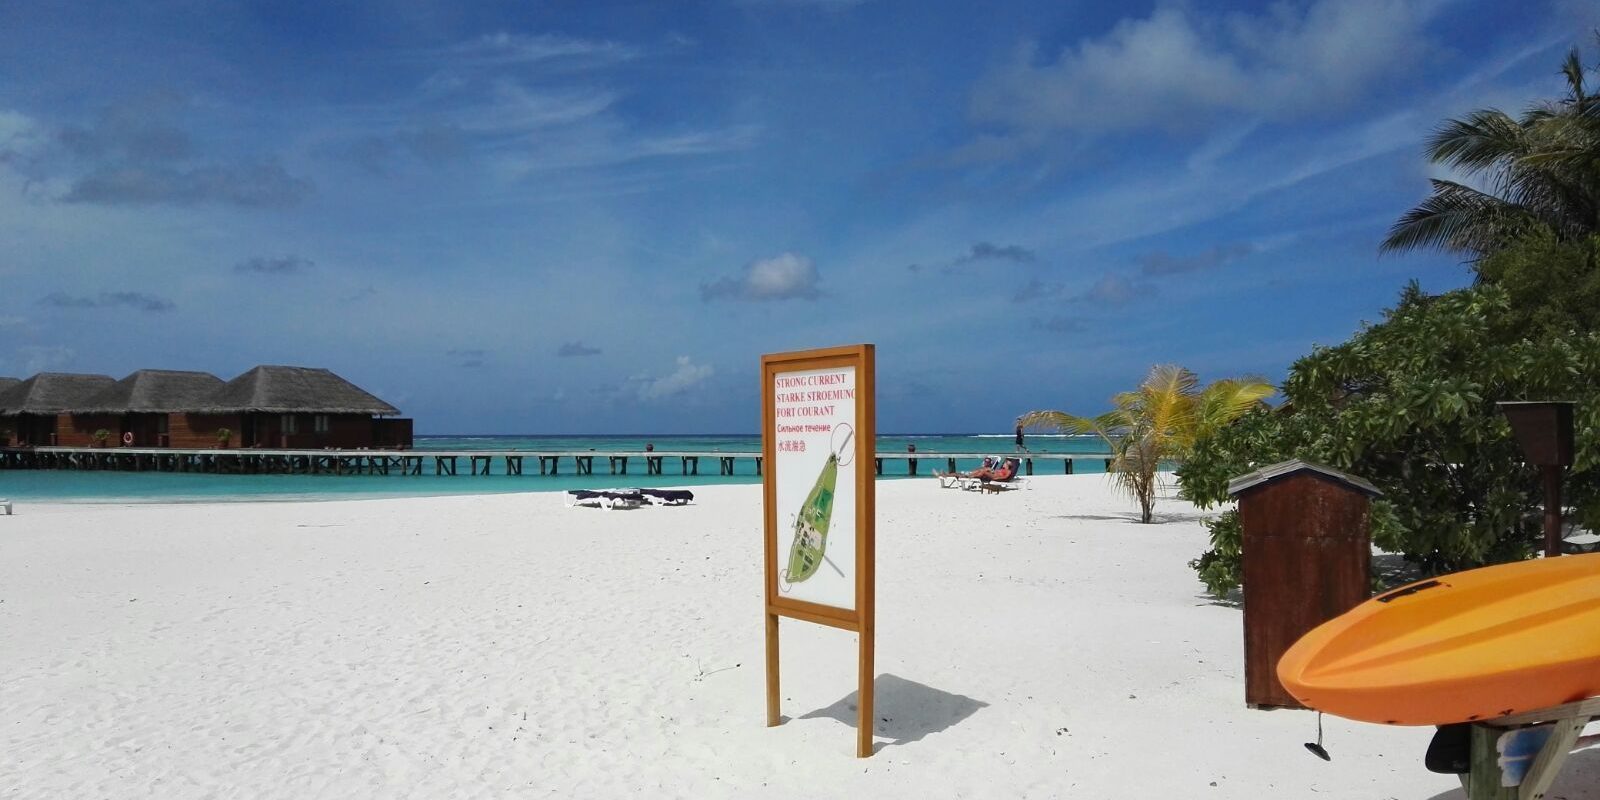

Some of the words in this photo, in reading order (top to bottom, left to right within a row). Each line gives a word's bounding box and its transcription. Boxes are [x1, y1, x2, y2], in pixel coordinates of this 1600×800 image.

[776, 377, 806, 388] STRONG
[808, 374, 846, 386] CURRENT
[776, 392, 805, 402] STARKE
[777, 407, 796, 417] FORT
[797, 406, 835, 416] COURANT
[777, 424, 803, 433] Сильное
[805, 424, 831, 432] течение
